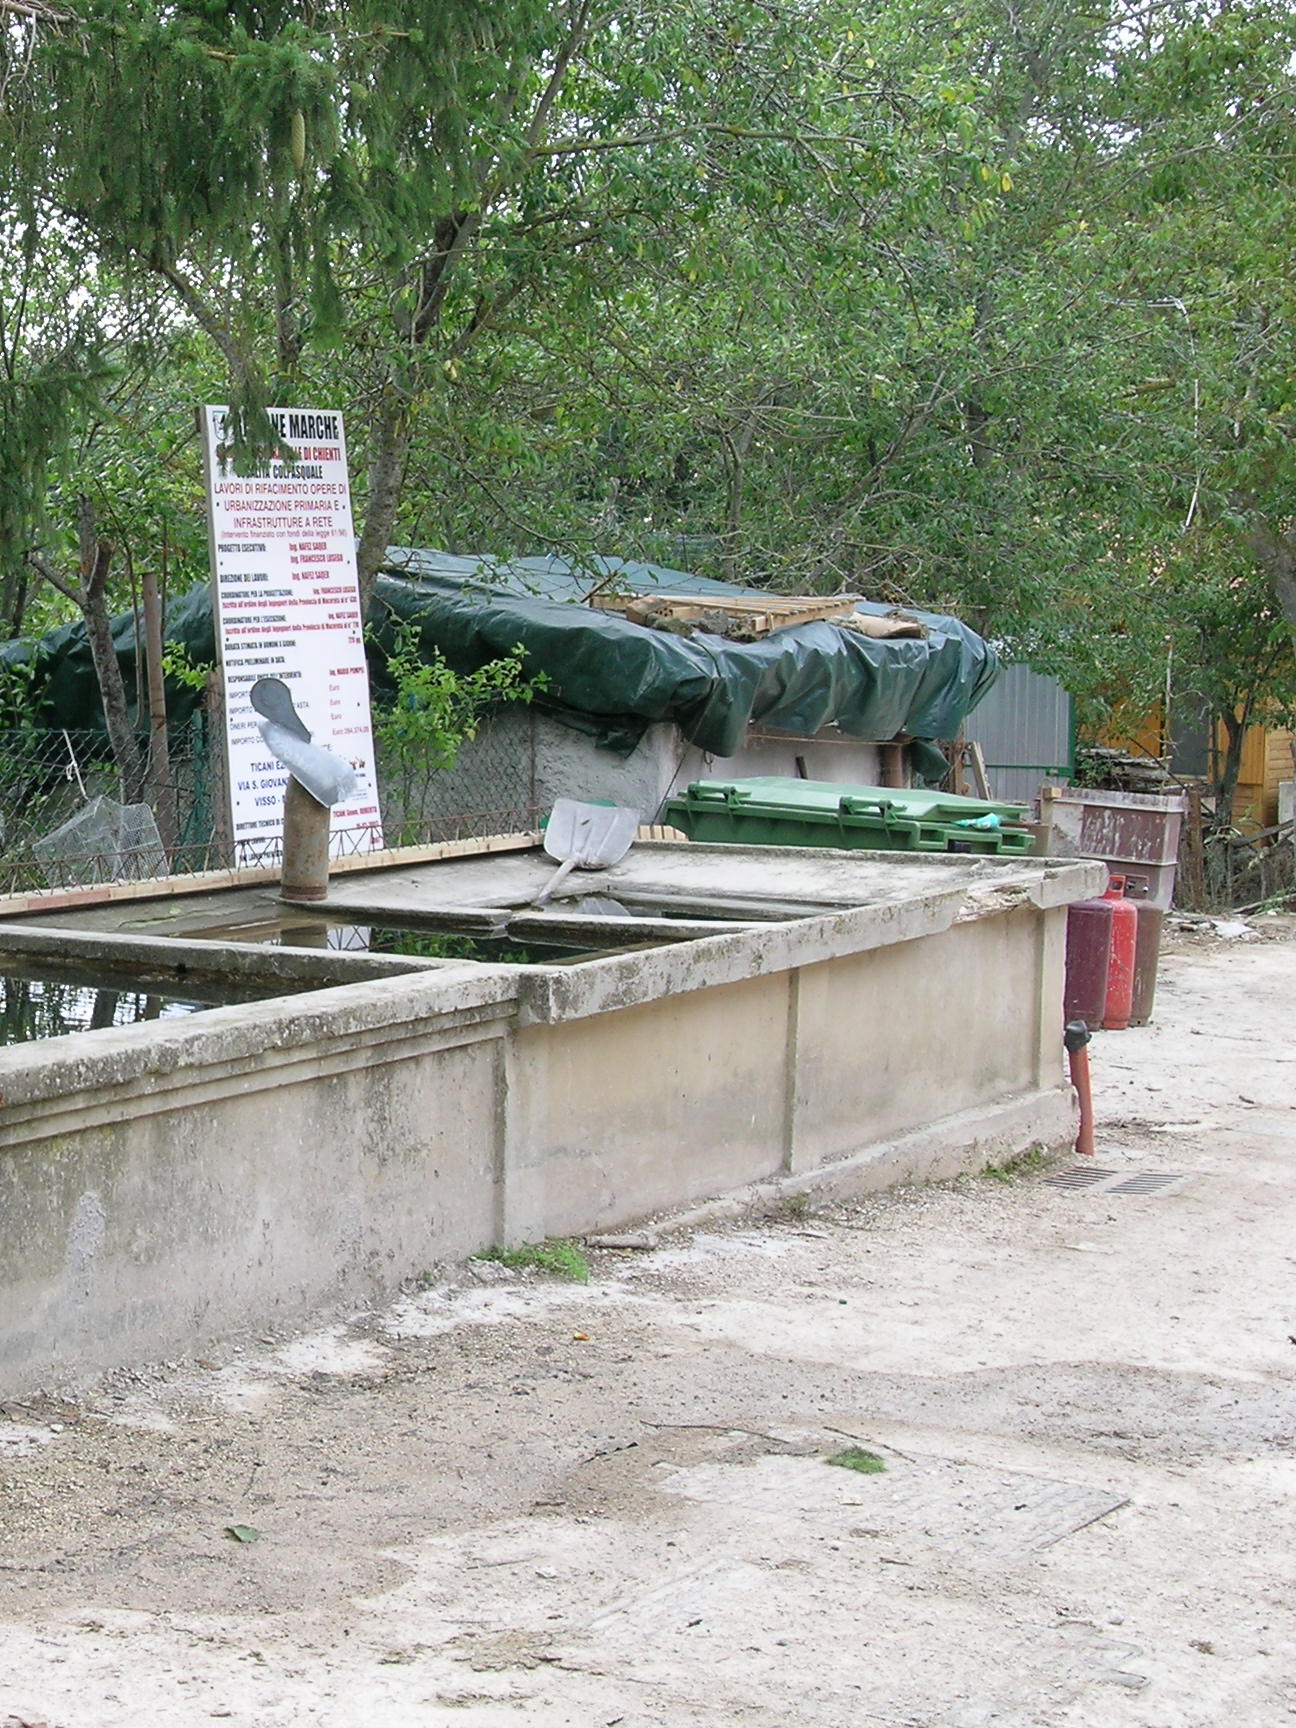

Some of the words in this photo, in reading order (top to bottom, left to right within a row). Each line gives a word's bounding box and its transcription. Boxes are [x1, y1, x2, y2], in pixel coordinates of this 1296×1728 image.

[289, 413, 340, 440] MARCHE
[313, 446, 341, 461] CHIENTI
[214, 483, 243, 494] LAVORI
[245, 483, 253, 494] DI
[255, 483, 309, 495] RIFACIMENTO
[311, 484, 337, 495] OPERE
[339, 484, 347, 494] DI
[224, 500, 292, 511] URBANIZZAZIONE
[294, 500, 333, 511] PRIMARIA
[334, 500, 339, 511] E
[233, 517, 303, 528] INFRASTRUTTURE
[305, 517, 311, 527] A
[312, 516, 333, 527] RETE
[238, 780, 251, 791] VIA
[255, 795, 277, 806] VISSO
